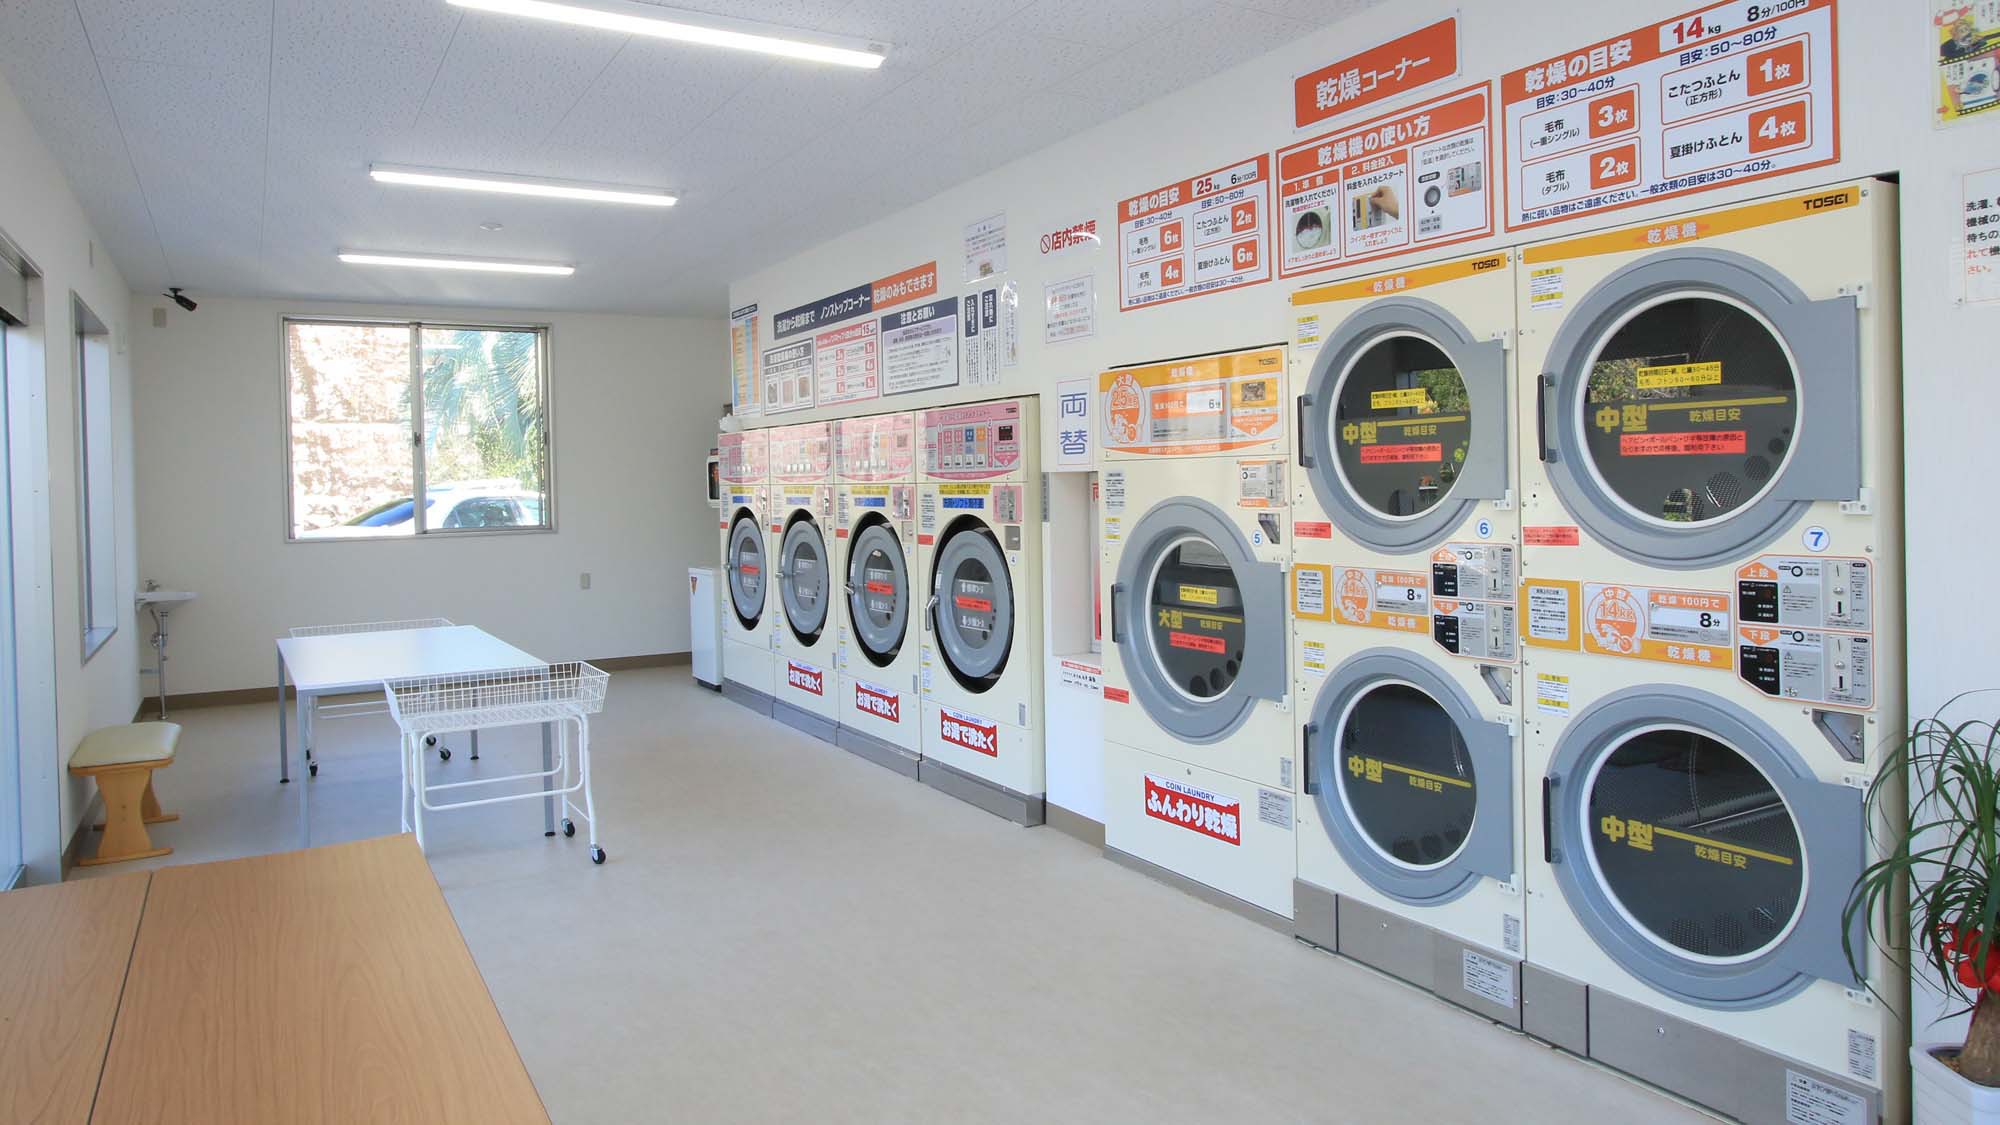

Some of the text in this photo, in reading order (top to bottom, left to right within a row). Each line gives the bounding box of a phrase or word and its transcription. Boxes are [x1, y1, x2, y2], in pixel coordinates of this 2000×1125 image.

[1672, 17, 1705, 45] 14
[1707, 23, 1722, 36] kg
[1524, 38, 1632, 94] 乾燥の目安
[1668, 57, 1792, 99] こたつふとん 1枚
[1315, 54, 1430, 111] 乾燥コーナー
[1684, 87, 1723, 108] (正方形)
[1544, 104, 1628, 134] 毛布 3枚
[1318, 114, 1431, 166] 乾燥機の使い方
[1670, 115, 1797, 160] 夏掛けふとん 4枚
[1545, 156, 1630, 184] 毛布 2枚
[1128, 187, 1180, 217] 乾燥の目安
[1196, 177, 1212, 195] 25
[1802, 192, 1850, 211] TOSEI
[1051, 219, 1097, 250] 店内禁煙
[1646, 221, 1697, 244] 乾燥機
[1471, 257, 1500, 271] TOSEI
[819, 293, 871, 320] ノンストップコーナー
[1060, 391, 1088, 456] 両替
[1595, 404, 1647, 433] 中型
[1689, 408, 1740, 424] 乾燥目安
[1342, 421, 1377, 445] 中型
[1254, 533, 1261, 545] 5
[1479, 521, 1489, 535] 6
[1809, 530, 1824, 548] 7
[1158, 608, 1183, 630] 大型
[1699, 612, 1721, 628] 8分
[1667, 645, 1712, 663] 乾燥機
[942, 719, 995, 752] お湯で洗たく
[1348, 755, 1383, 783] 中型
[1165, 780, 1215, 802] COIN LAUNDRY
[1147, 790, 1237, 840] ふんわり乾燥
[1601, 814, 1653, 852] 中型
[1694, 843, 1748, 870] 乾燥目安
